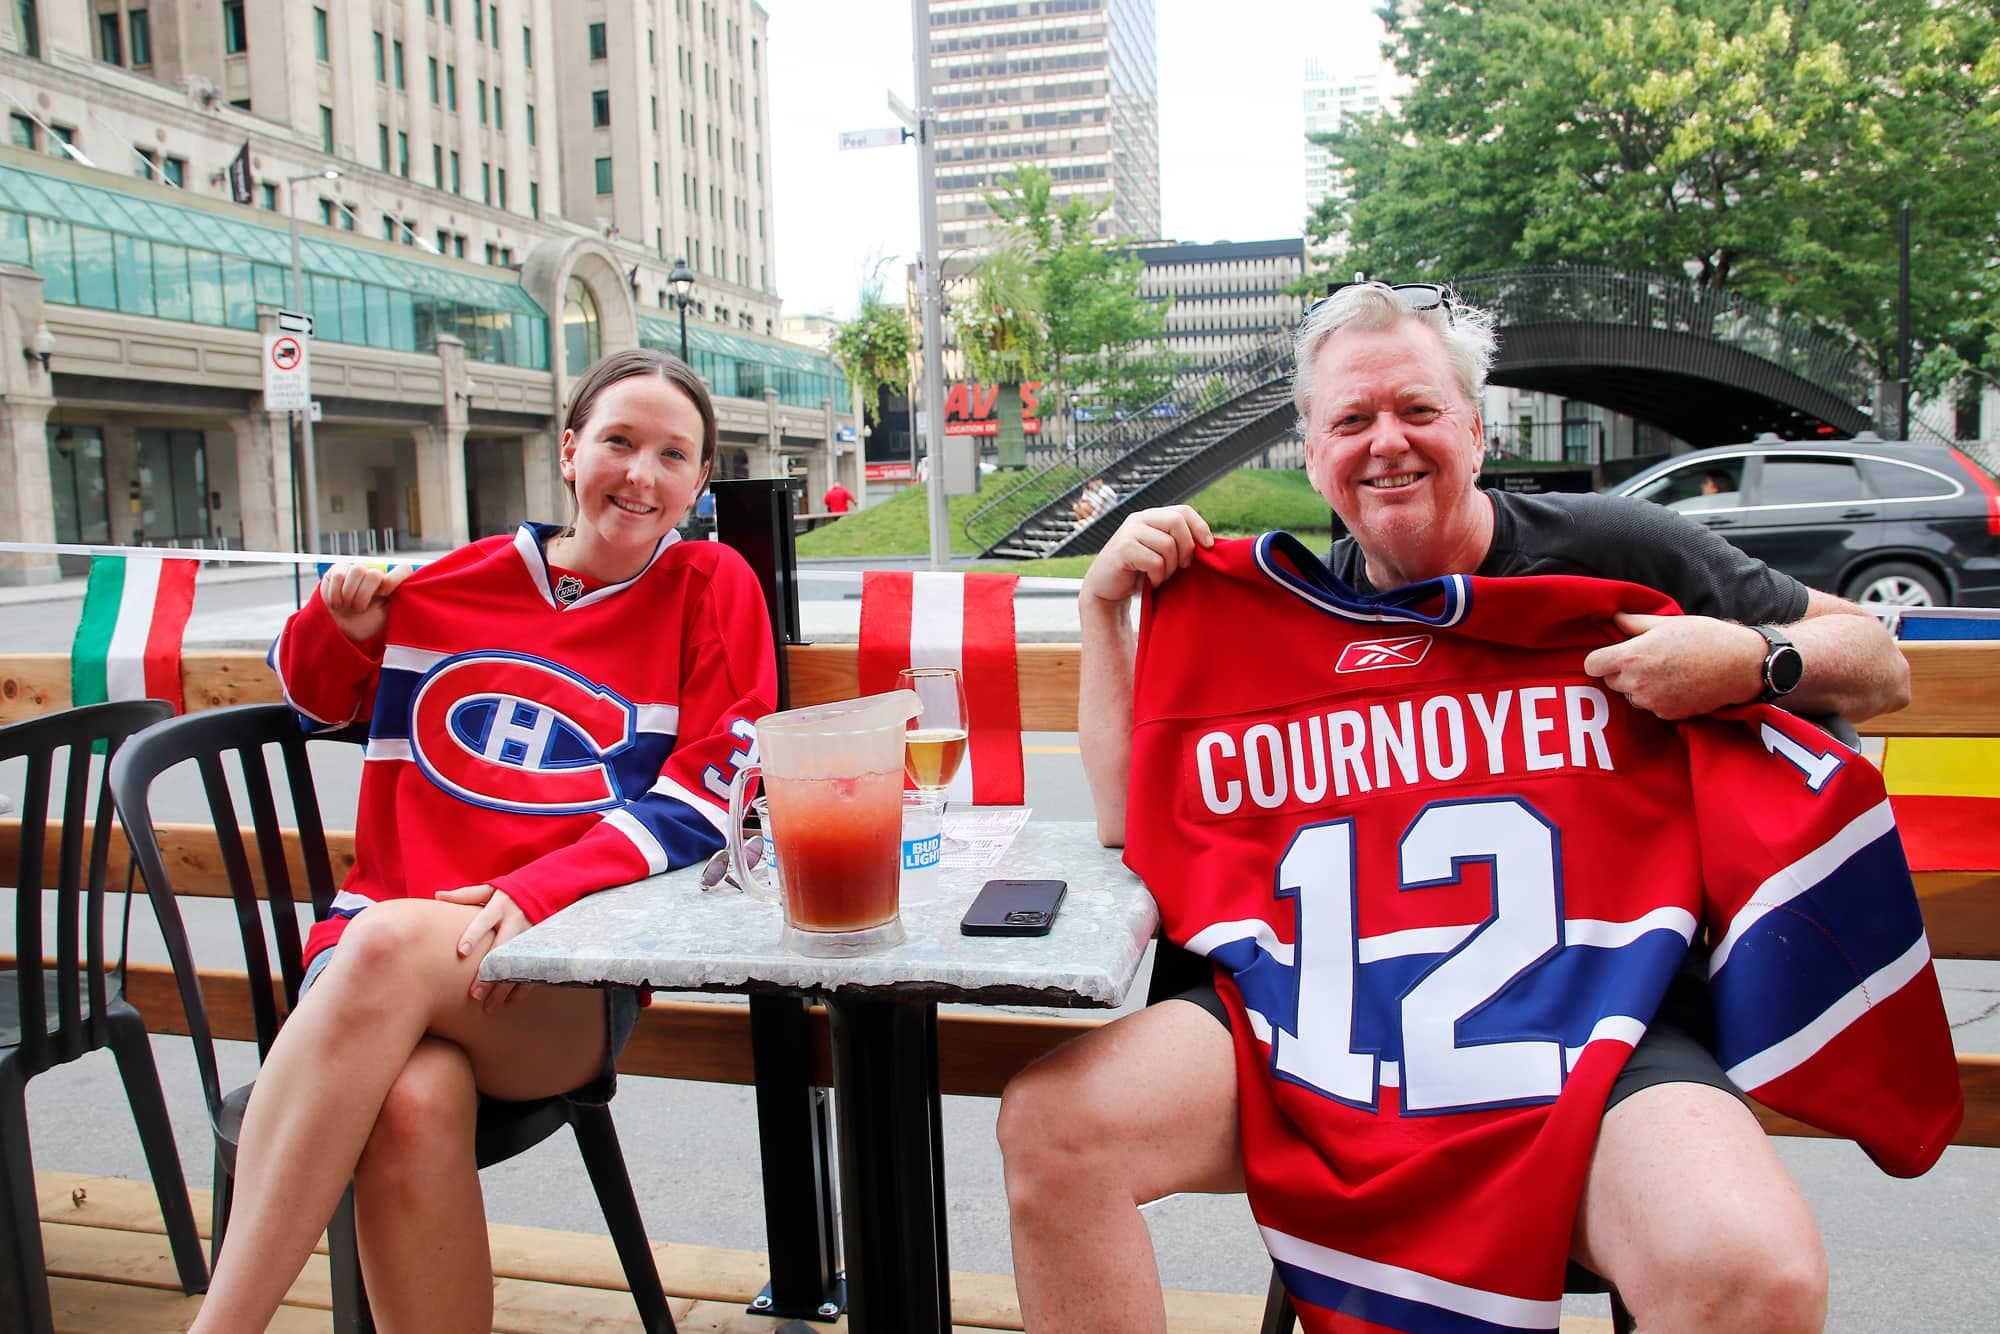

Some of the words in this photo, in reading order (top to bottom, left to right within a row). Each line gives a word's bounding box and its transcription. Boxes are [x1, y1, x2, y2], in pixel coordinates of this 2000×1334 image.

[944, 381, 1041, 419] AVS
[561, 585, 577, 597] NHL
[1196, 686, 1614, 814] COURNOYER
[905, 848, 941, 867] LIGHT
[912, 838, 940, 855] BUD
[1270, 795, 1566, 1117] 12
